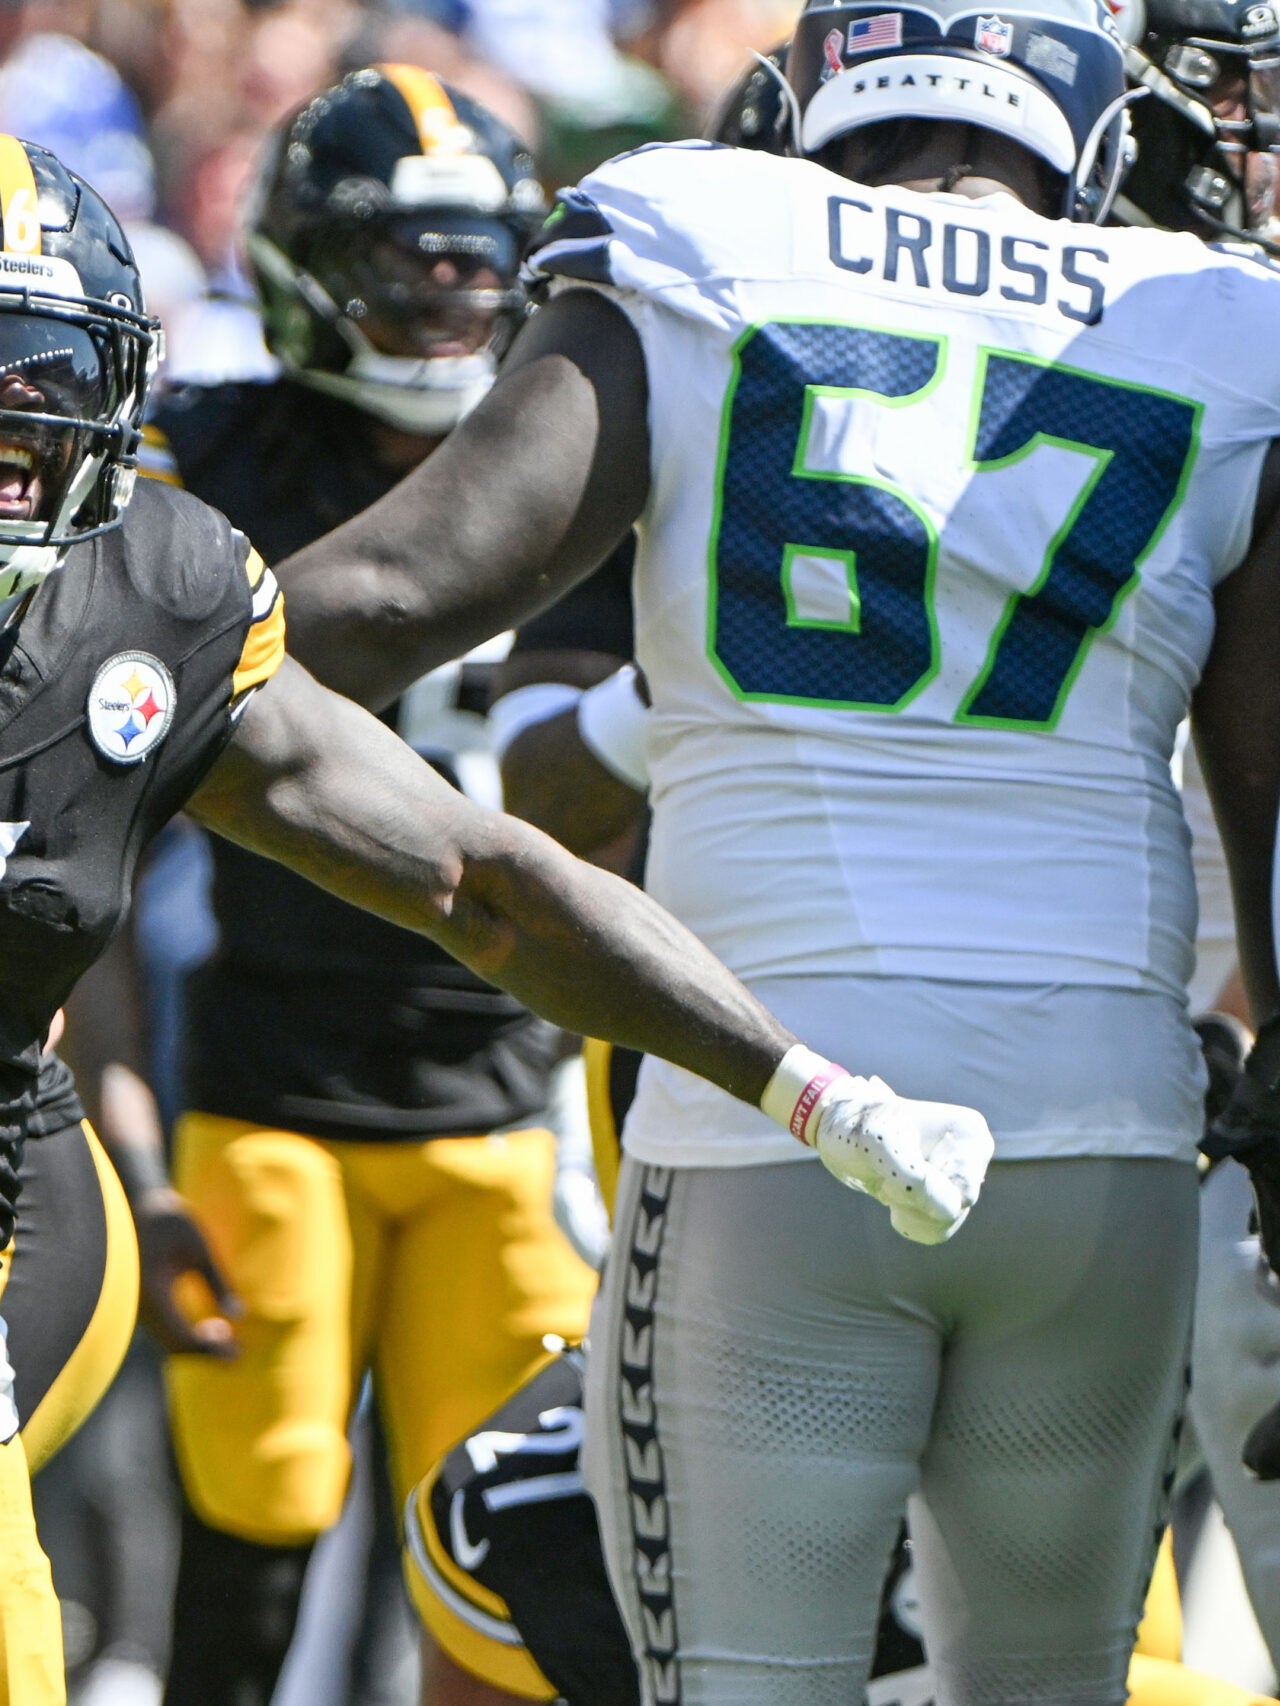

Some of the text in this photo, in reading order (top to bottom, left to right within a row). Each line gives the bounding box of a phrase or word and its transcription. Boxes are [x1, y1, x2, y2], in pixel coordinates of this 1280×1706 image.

[853, 74, 1020, 107] SEATTLE
[4, 188, 40, 252] 6
[827, 195, 1109, 326] CROSS
[706, 315, 1205, 732] 67
[98, 697, 131, 712] Steelers
[802, 1079, 827, 1106] FAIL
